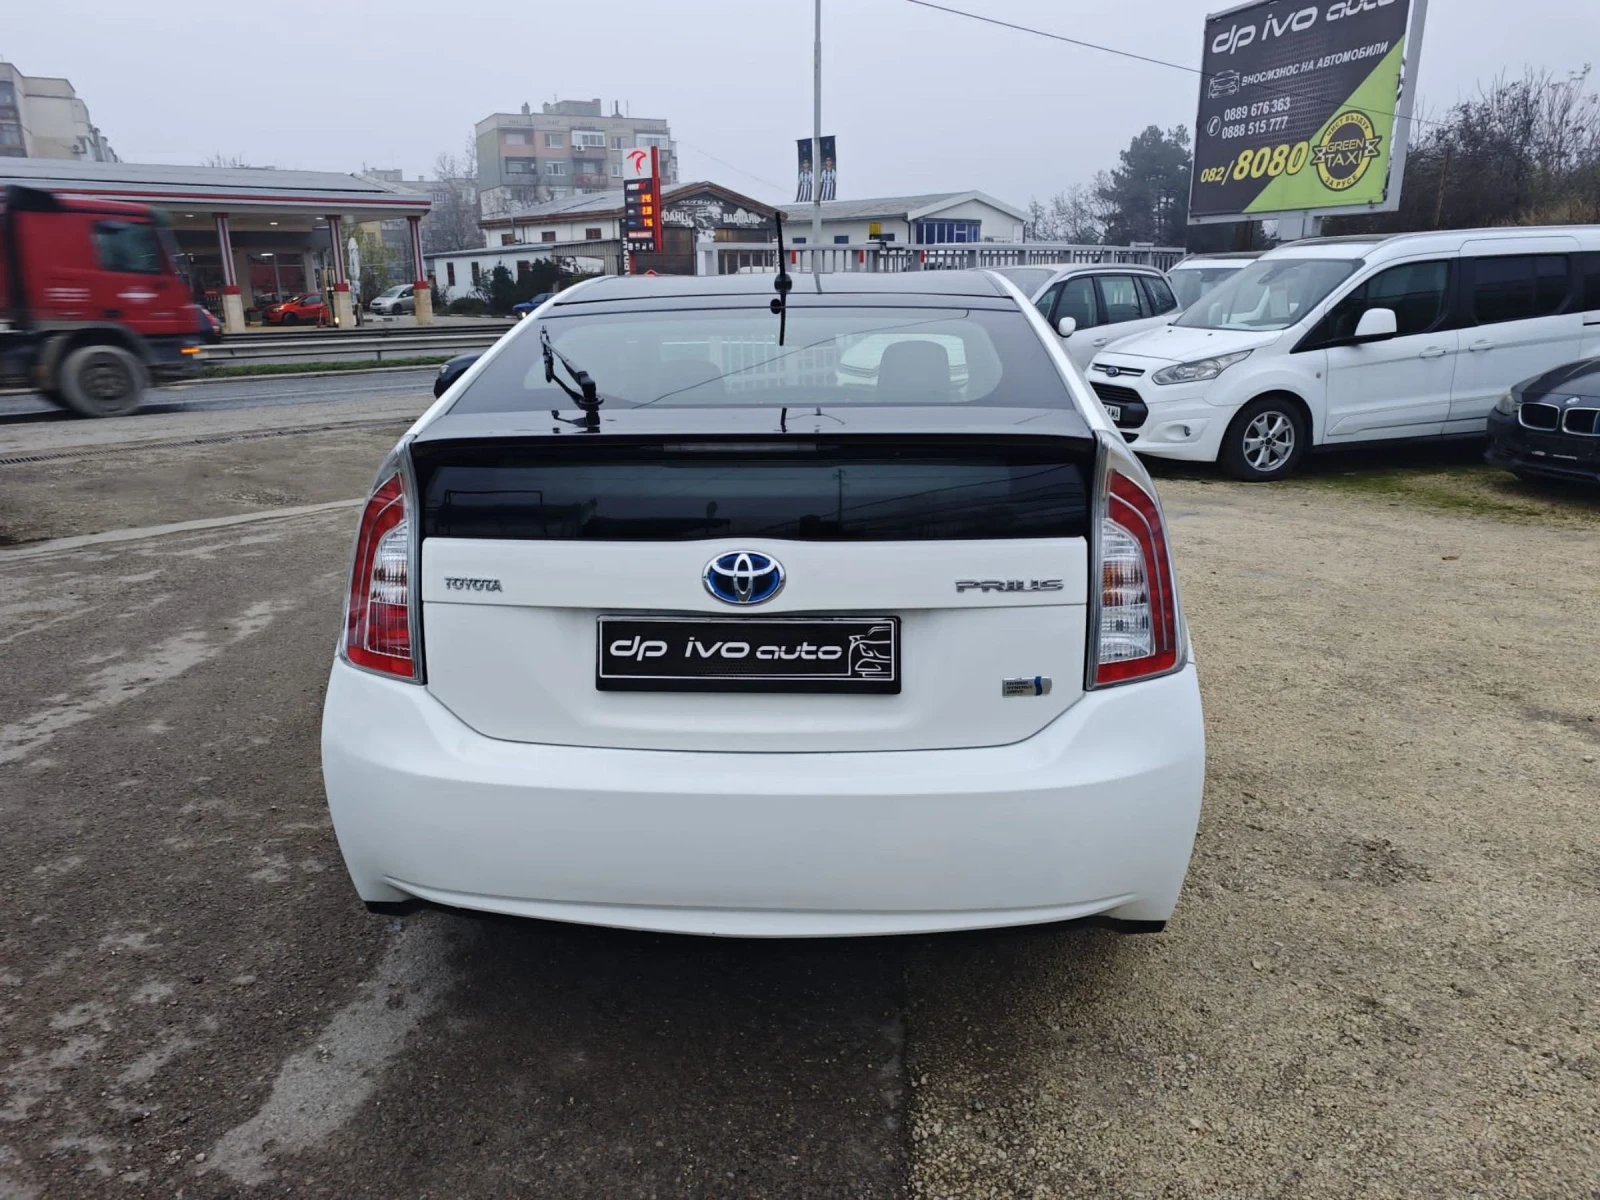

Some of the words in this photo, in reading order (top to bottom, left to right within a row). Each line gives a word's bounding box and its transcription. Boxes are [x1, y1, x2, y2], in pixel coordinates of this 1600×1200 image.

[1212, 24, 1256, 55] dp
[1261, 6, 1318, 41] ivo
[1241, 63, 1300, 86] ВНОС/ИЗНОС
[1300, 60, 1314, 73] НА
[1315, 41, 1389, 68] АВТОМОБИЛИ
[1224, 105, 1248, 122] 0889
[1250, 101, 1269, 117] 676
[1271, 96, 1291, 113] 363
[1222, 124, 1246, 139] 0888
[1247, 119, 1267, 135] 515
[1269, 115, 1289, 131] 777
[1326, 138, 1364, 152] GREEN
[1325, 150, 1363, 168] TAXI
[1335, 173, 1358, 188] РУСЕ
[444, 577, 503, 593] TOYOTA
[955, 579, 1064, 593] PRIUS
[609, 635, 668, 662] dp
[684, 637, 750, 658] ivo
[755, 642, 843, 660] auto
